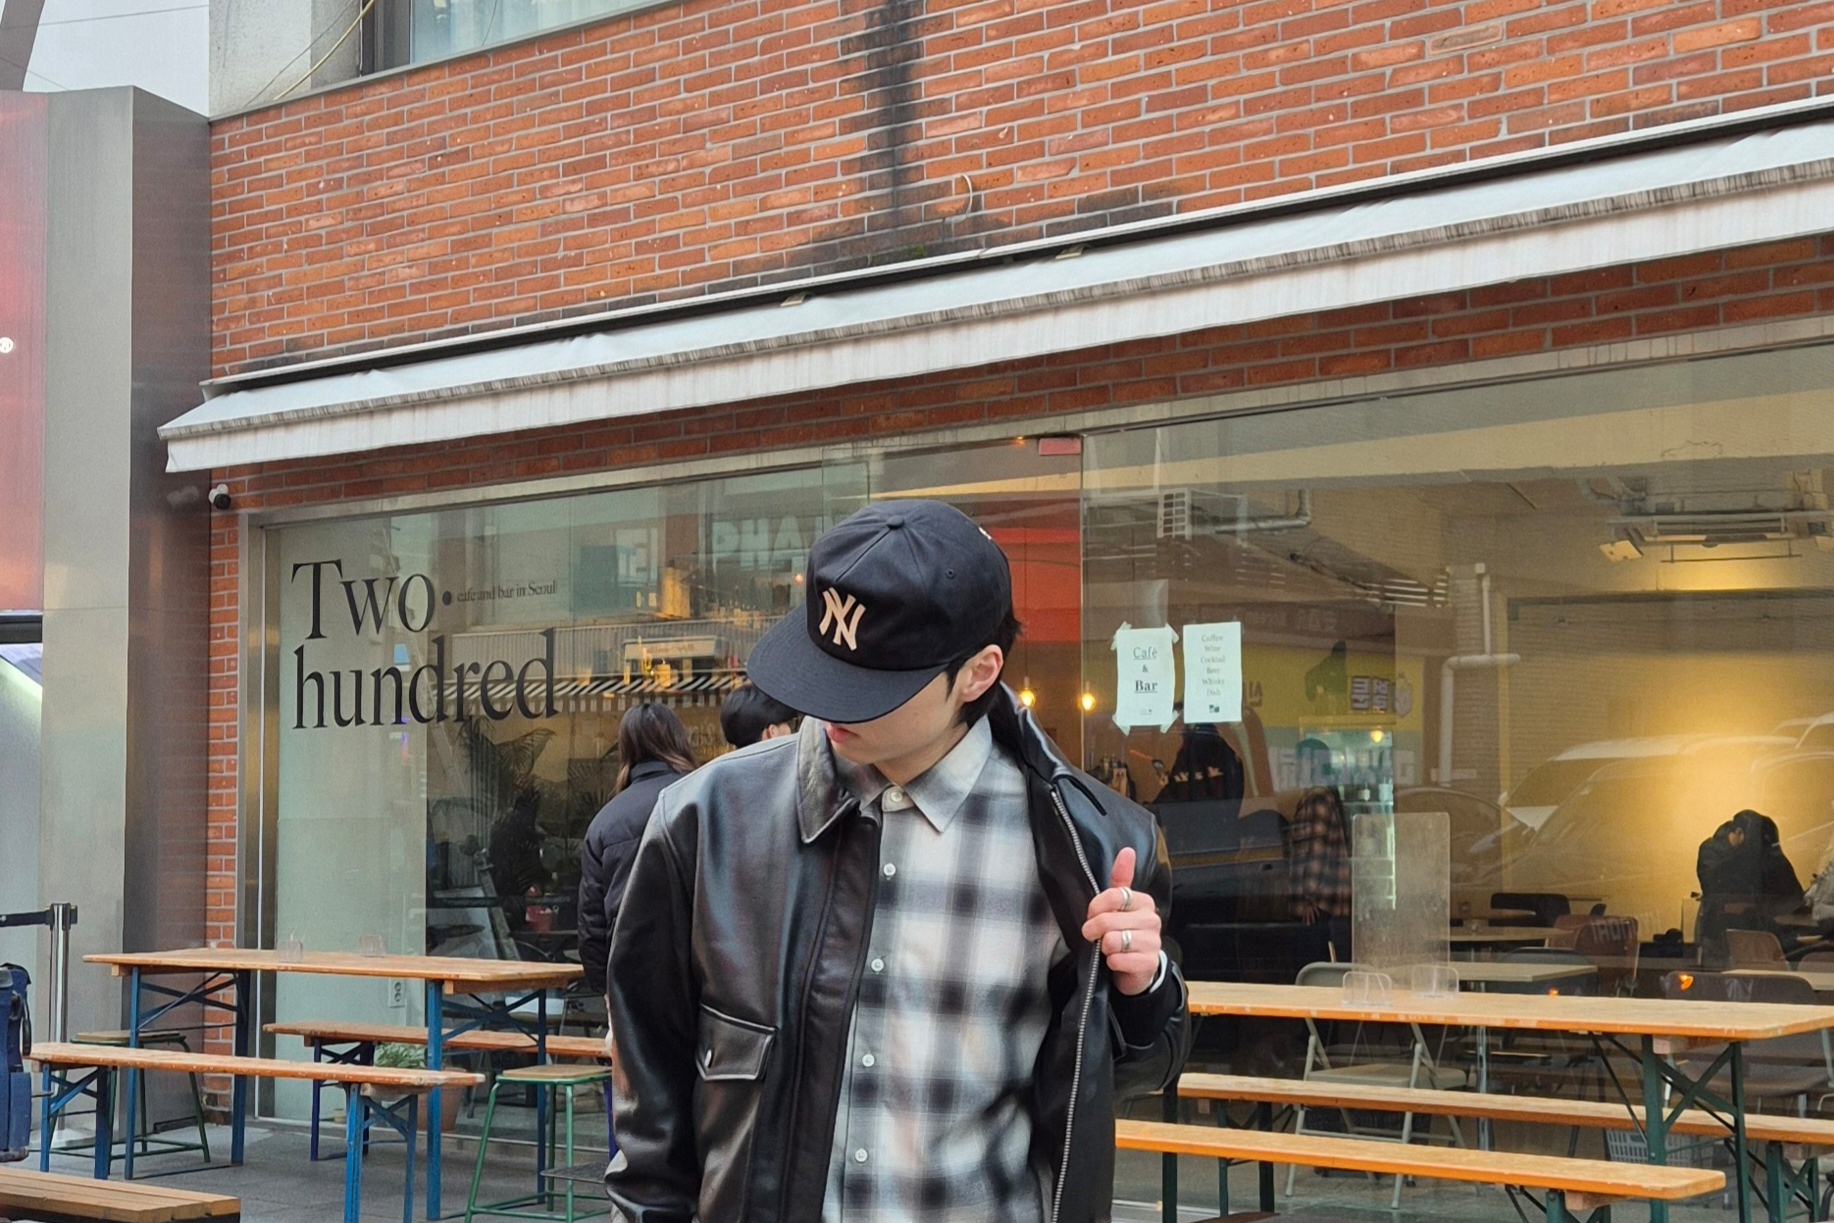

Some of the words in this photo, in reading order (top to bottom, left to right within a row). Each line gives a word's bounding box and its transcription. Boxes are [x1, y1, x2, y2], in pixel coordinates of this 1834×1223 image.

[478, 585, 496, 601] and
[497, 584, 514, 600] bar
[516, 582, 526, 598] in
[528, 580, 556, 596] Seoul
[291, 558, 436, 640] Two
[818, 586, 867, 651] NY
[1201, 634, 1223, 643] Coffee
[1204, 644, 1221, 652] Wine
[1200, 655, 1226, 664] Cocktail
[1142, 665, 1149, 673] &
[1206, 667, 1220, 675] Beer
[292, 627, 559, 730] hundred
[1135, 679, 1158, 692] Bar
